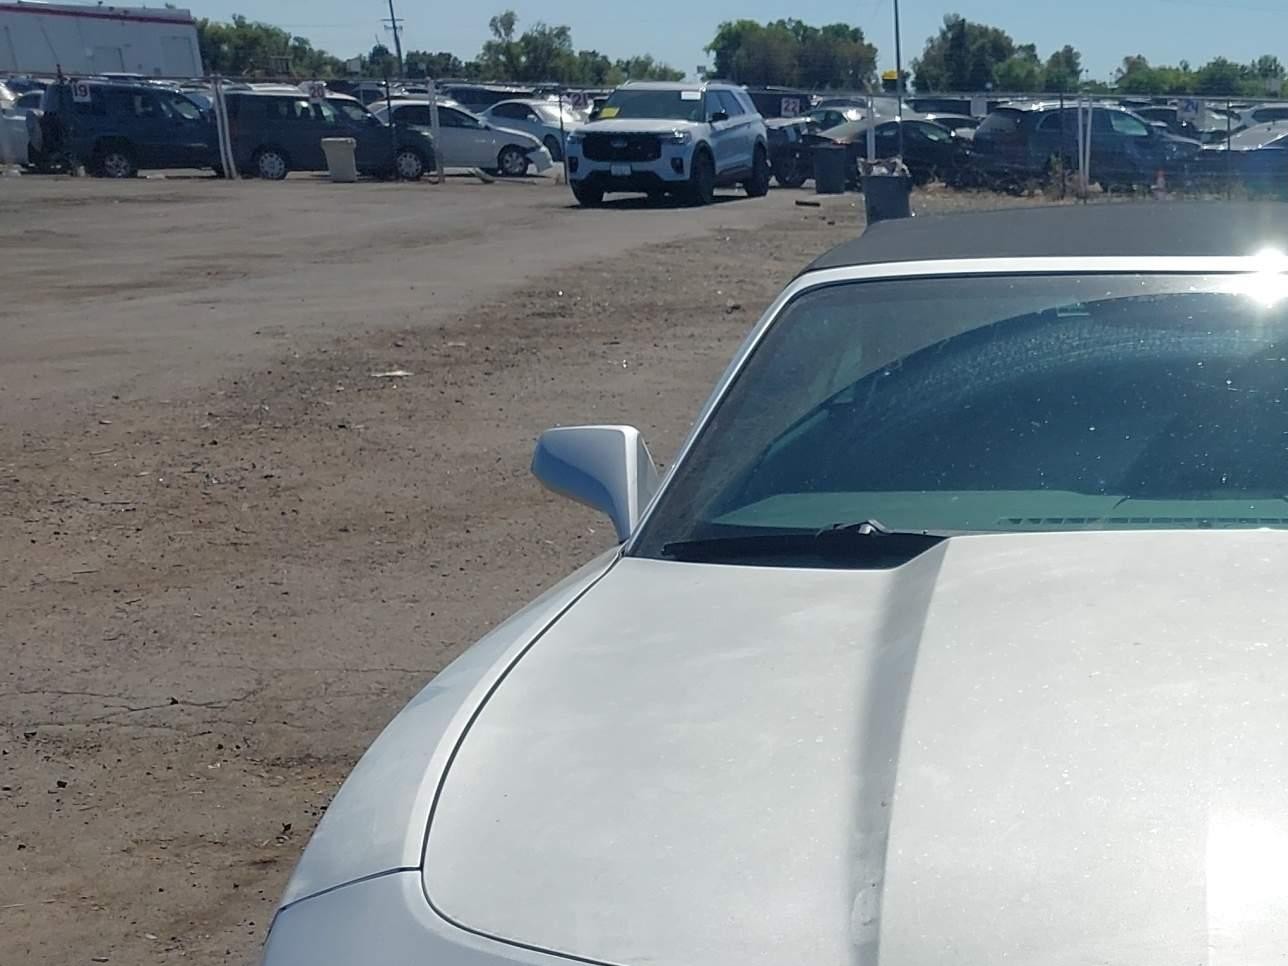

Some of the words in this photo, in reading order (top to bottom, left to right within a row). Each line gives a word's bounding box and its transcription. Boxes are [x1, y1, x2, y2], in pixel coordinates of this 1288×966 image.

[74, 84, 88, 97] 19
[571, 93, 589, 107] 21
[783, 100, 799, 112] 22
